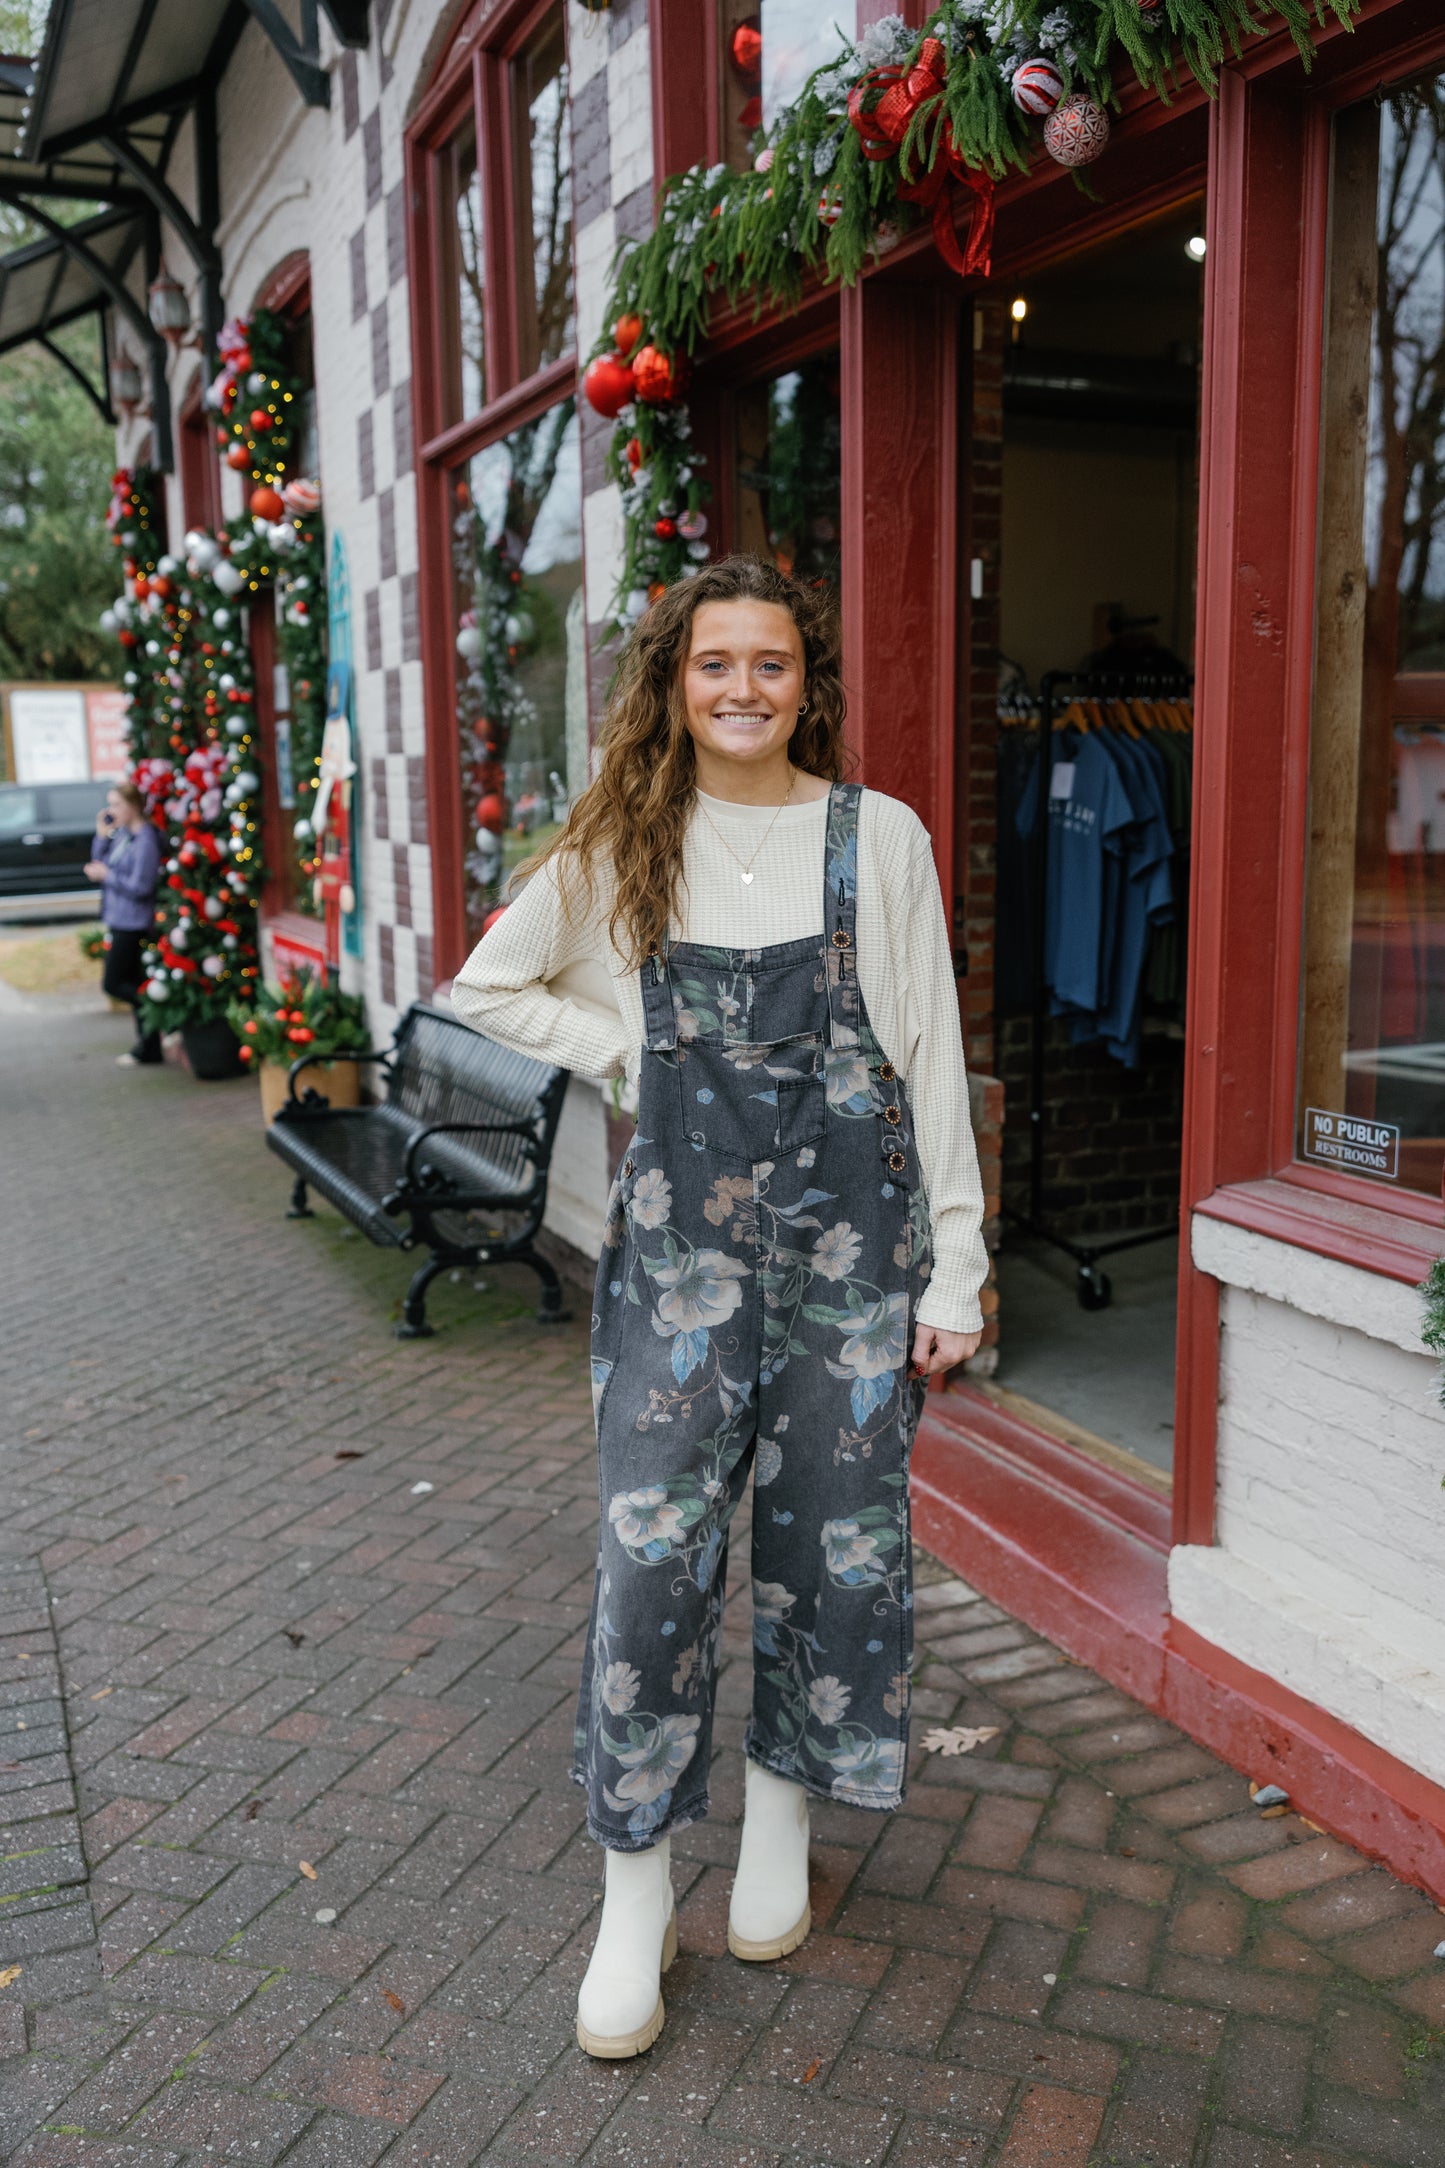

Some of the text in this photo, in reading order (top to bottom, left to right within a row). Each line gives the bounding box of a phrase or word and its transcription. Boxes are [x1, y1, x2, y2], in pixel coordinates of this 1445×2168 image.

[1314, 1115, 1390, 1148] NO PUBLIC
[1315, 1140, 1387, 1169] RESTROOMS
